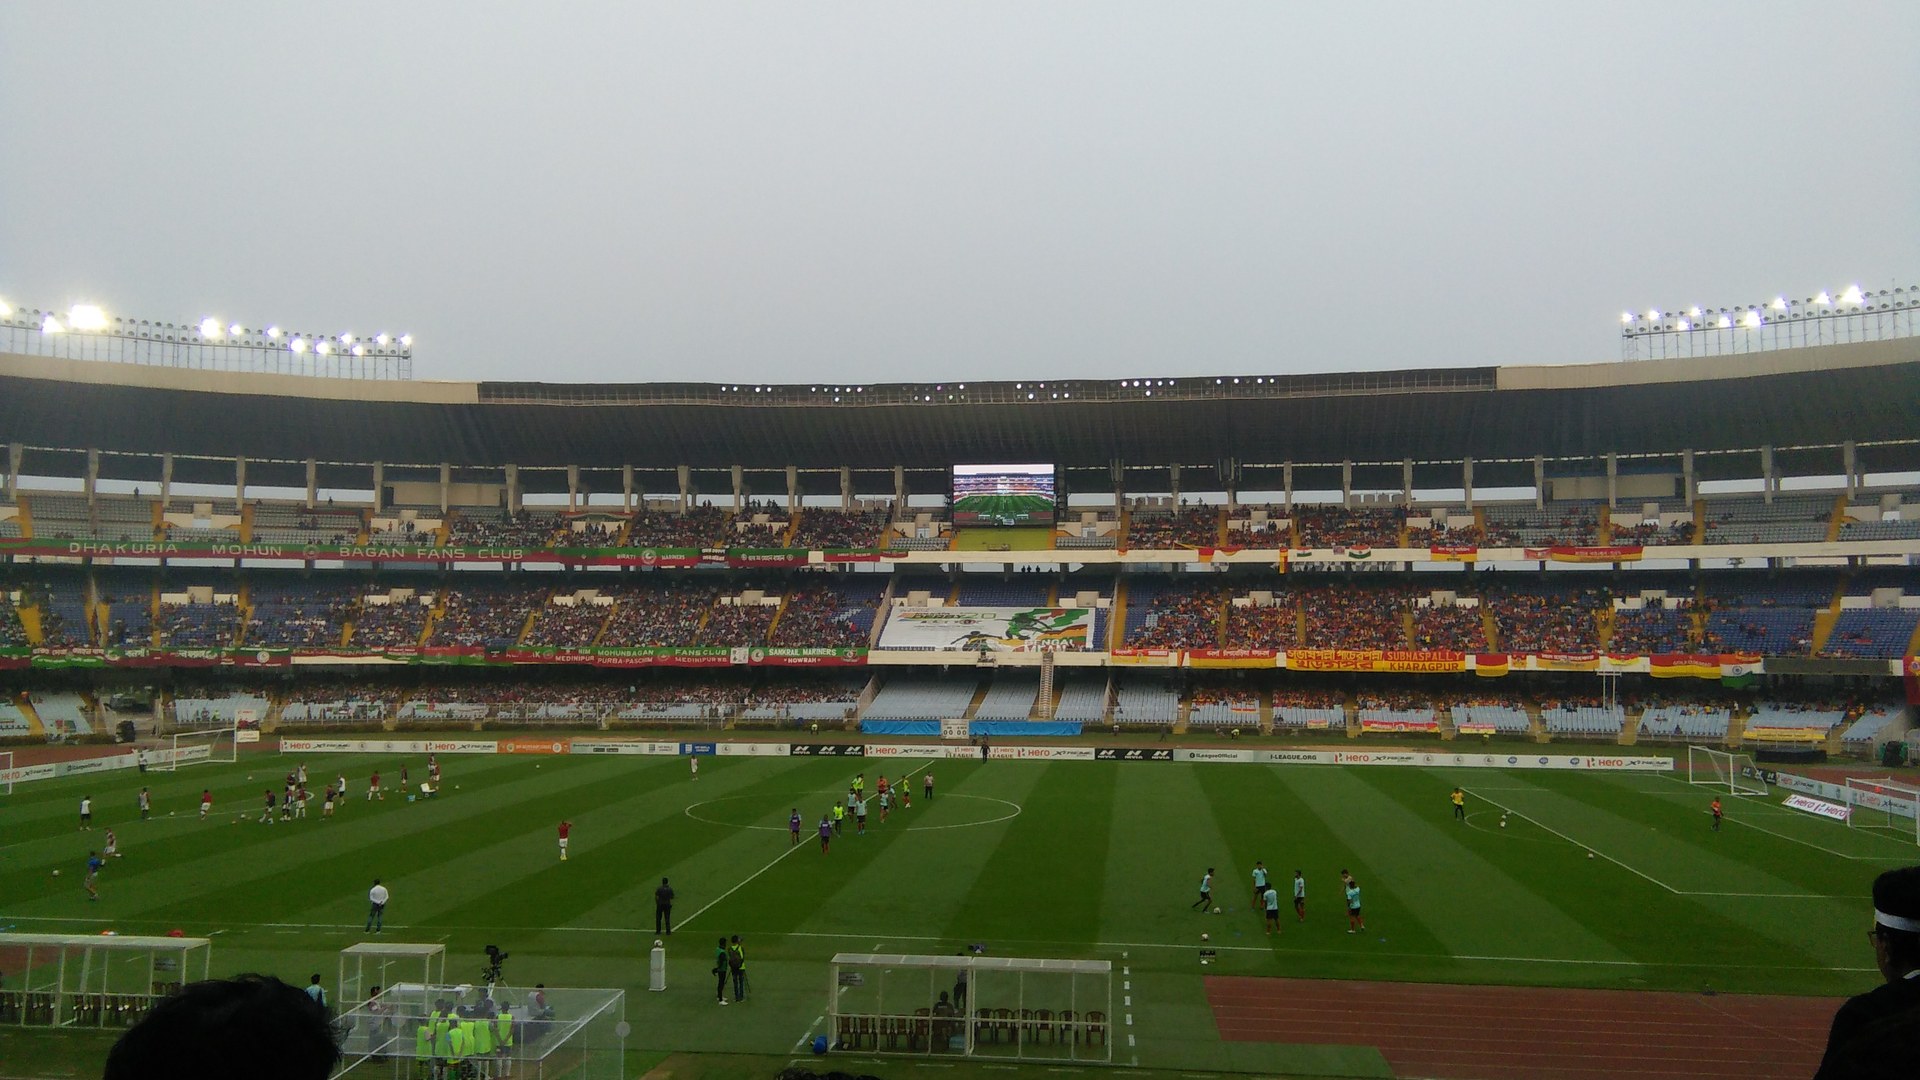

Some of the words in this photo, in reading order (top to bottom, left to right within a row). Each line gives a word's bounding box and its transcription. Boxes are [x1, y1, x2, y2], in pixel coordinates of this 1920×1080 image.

[69, 542, 178, 554] DHAKURIA
[212, 544, 282, 556] MOHUN
[339, 547, 405, 557] BAGAN
[417, 548, 466, 559] FANS
[478, 549, 523, 559] CLUB
[598, 649, 654, 657] MOHUNBAGAN
[1387, 651, 1463, 661] SUBHASPALLY
[1389, 662, 1459, 671] KHARAGPUR
[1794, 799, 1816, 809] Hero
[1824, 806, 1847, 817] Hero
